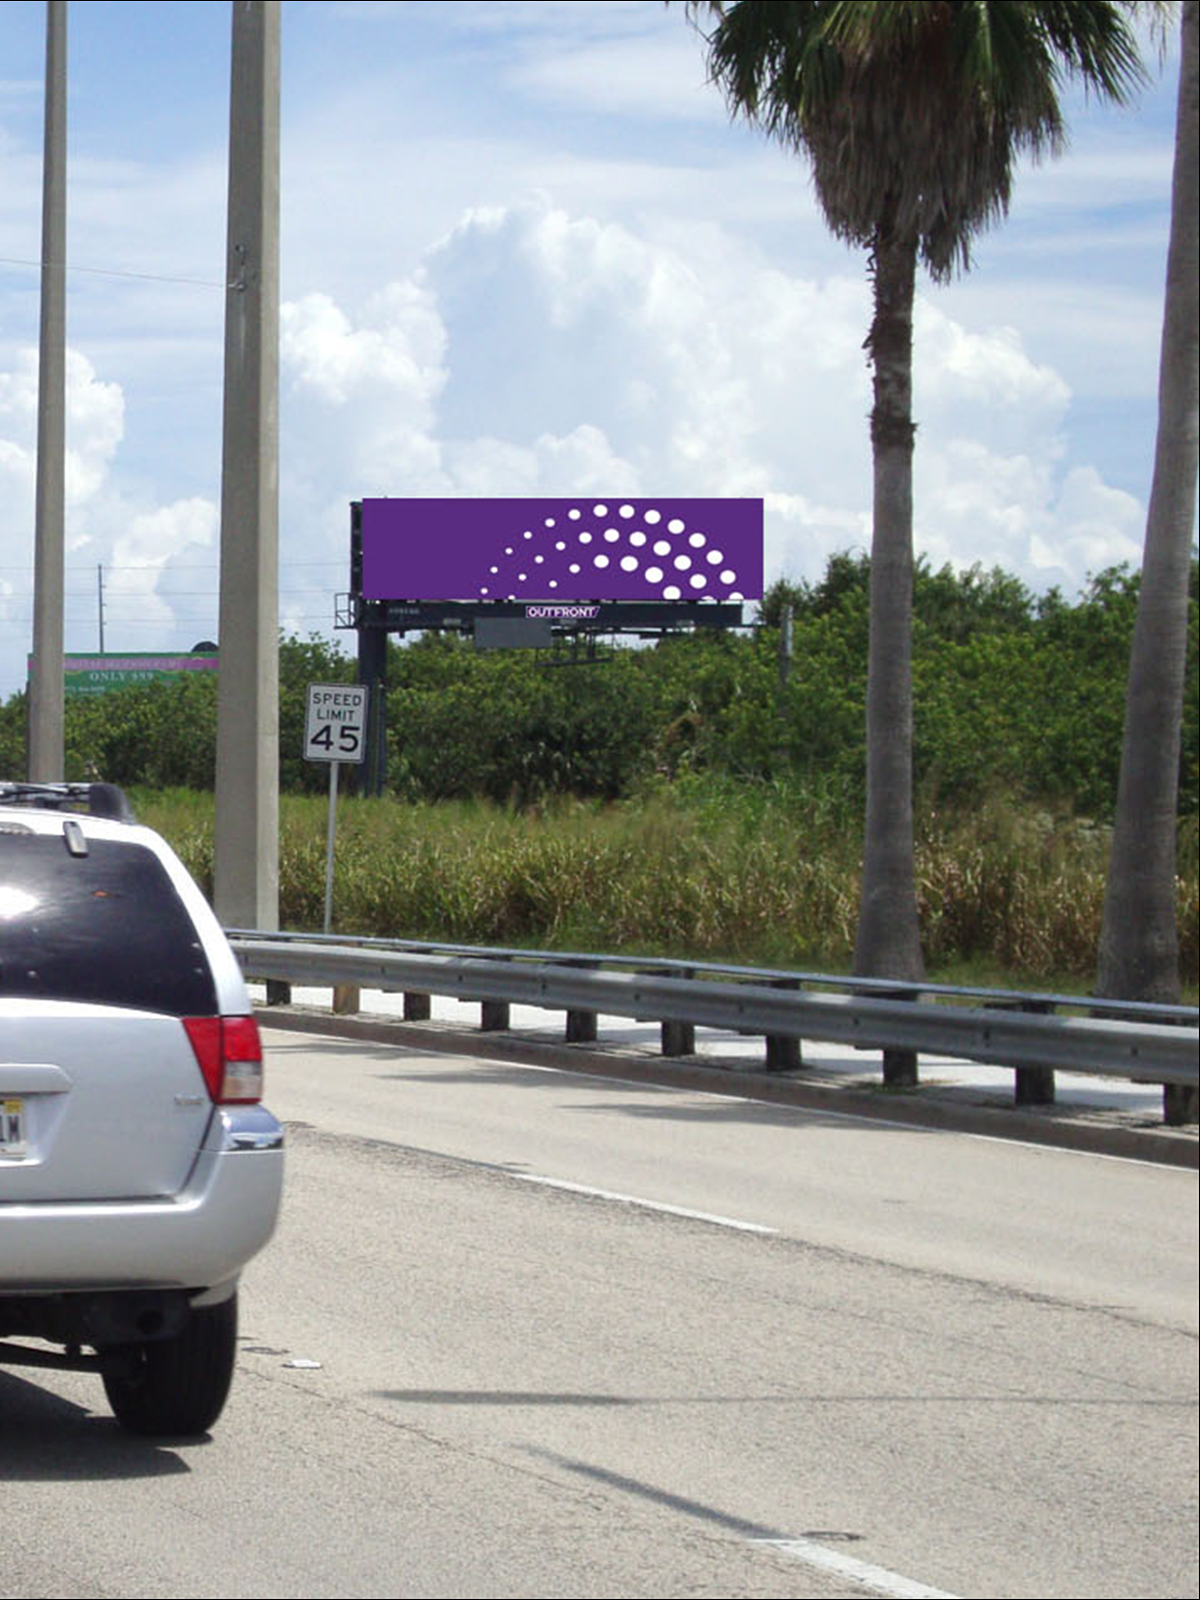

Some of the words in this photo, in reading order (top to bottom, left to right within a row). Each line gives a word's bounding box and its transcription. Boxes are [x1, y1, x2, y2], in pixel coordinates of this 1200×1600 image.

[528, 606, 596, 617] OUTFRONT
[90, 672, 125, 681] ONLY
[312, 692, 362, 706] SPEED
[316, 708, 354, 722] LIMIT
[310, 724, 360, 752] 45
